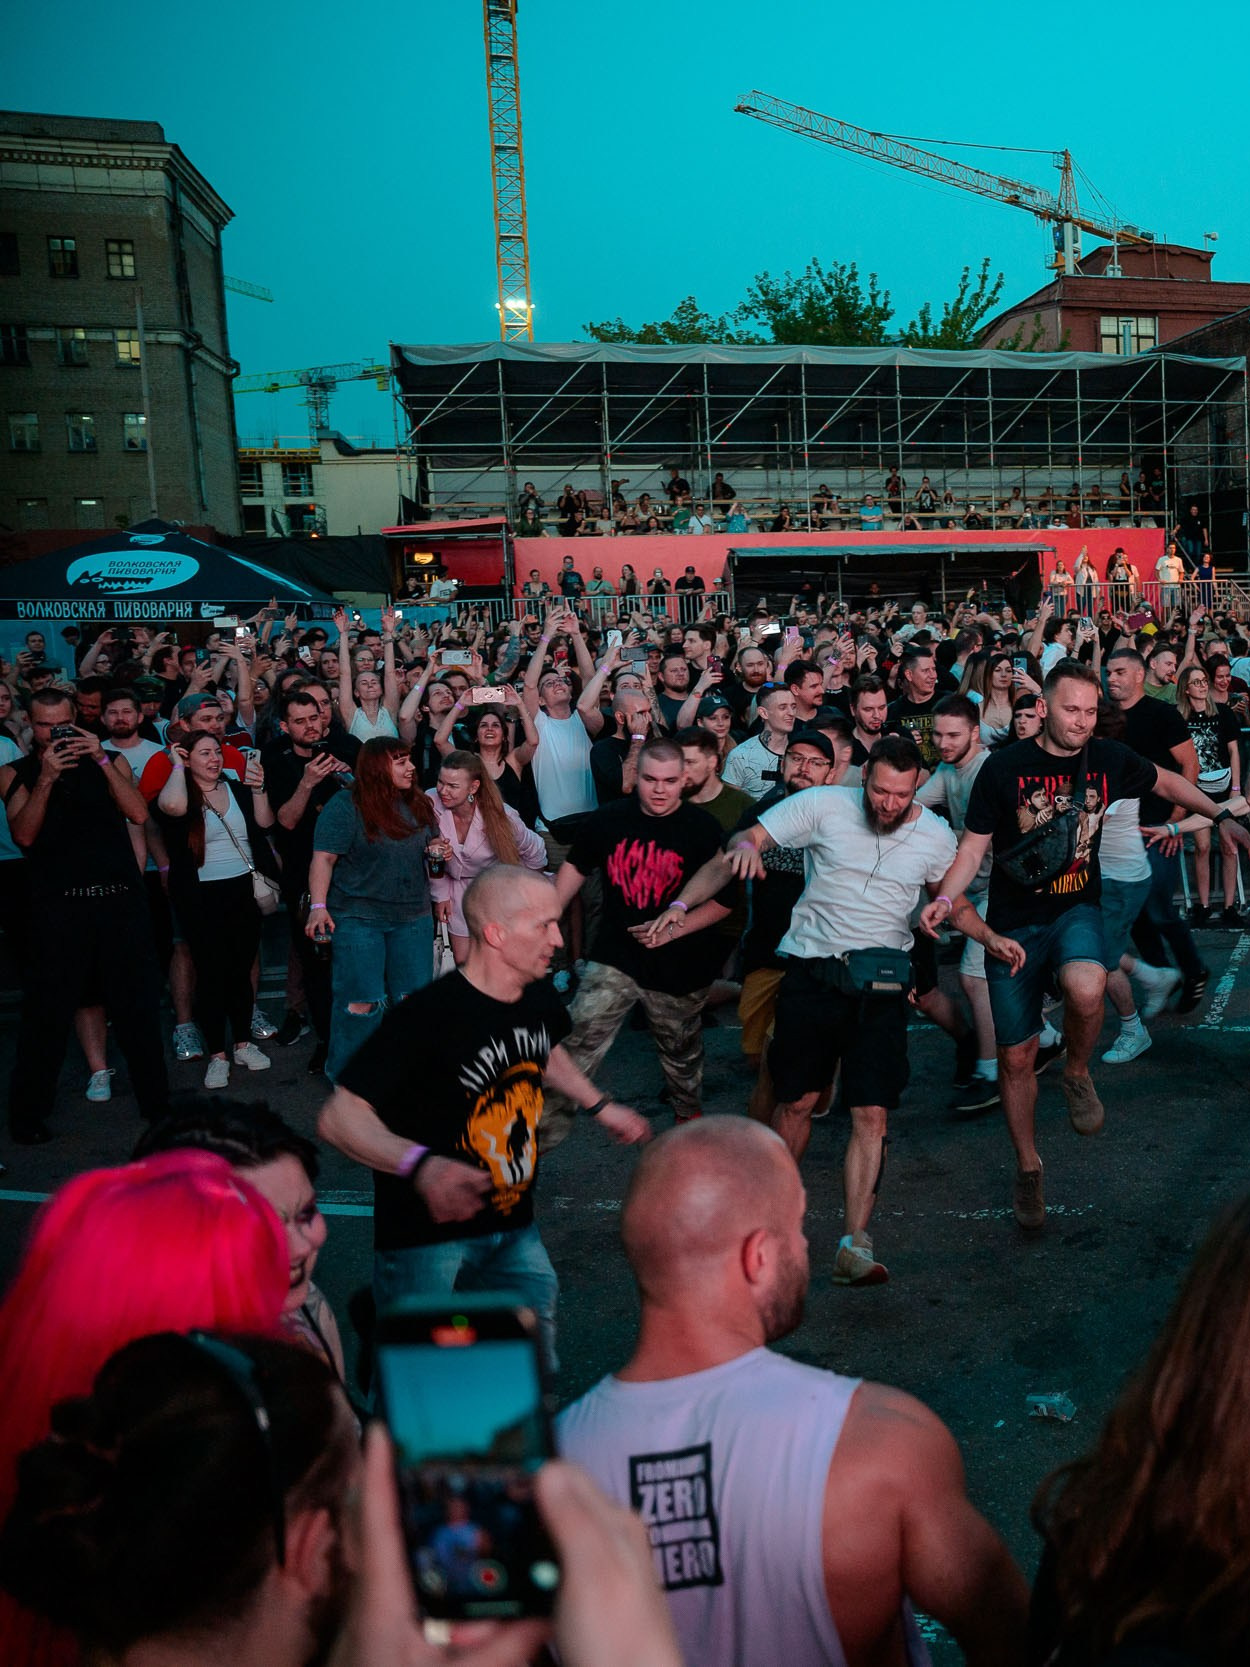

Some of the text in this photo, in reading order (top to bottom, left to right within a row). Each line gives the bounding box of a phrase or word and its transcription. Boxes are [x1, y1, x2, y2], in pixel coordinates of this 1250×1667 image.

[108, 560, 182, 568] ВОЛКОВСКАЯ
[107, 567, 177, 575] ПИВОВАРНЯ
[17, 602, 193, 618] ВОЛКОВСКАЯ ПИВОВАРНЯ
[637, 1477, 707, 1524] ZERO
